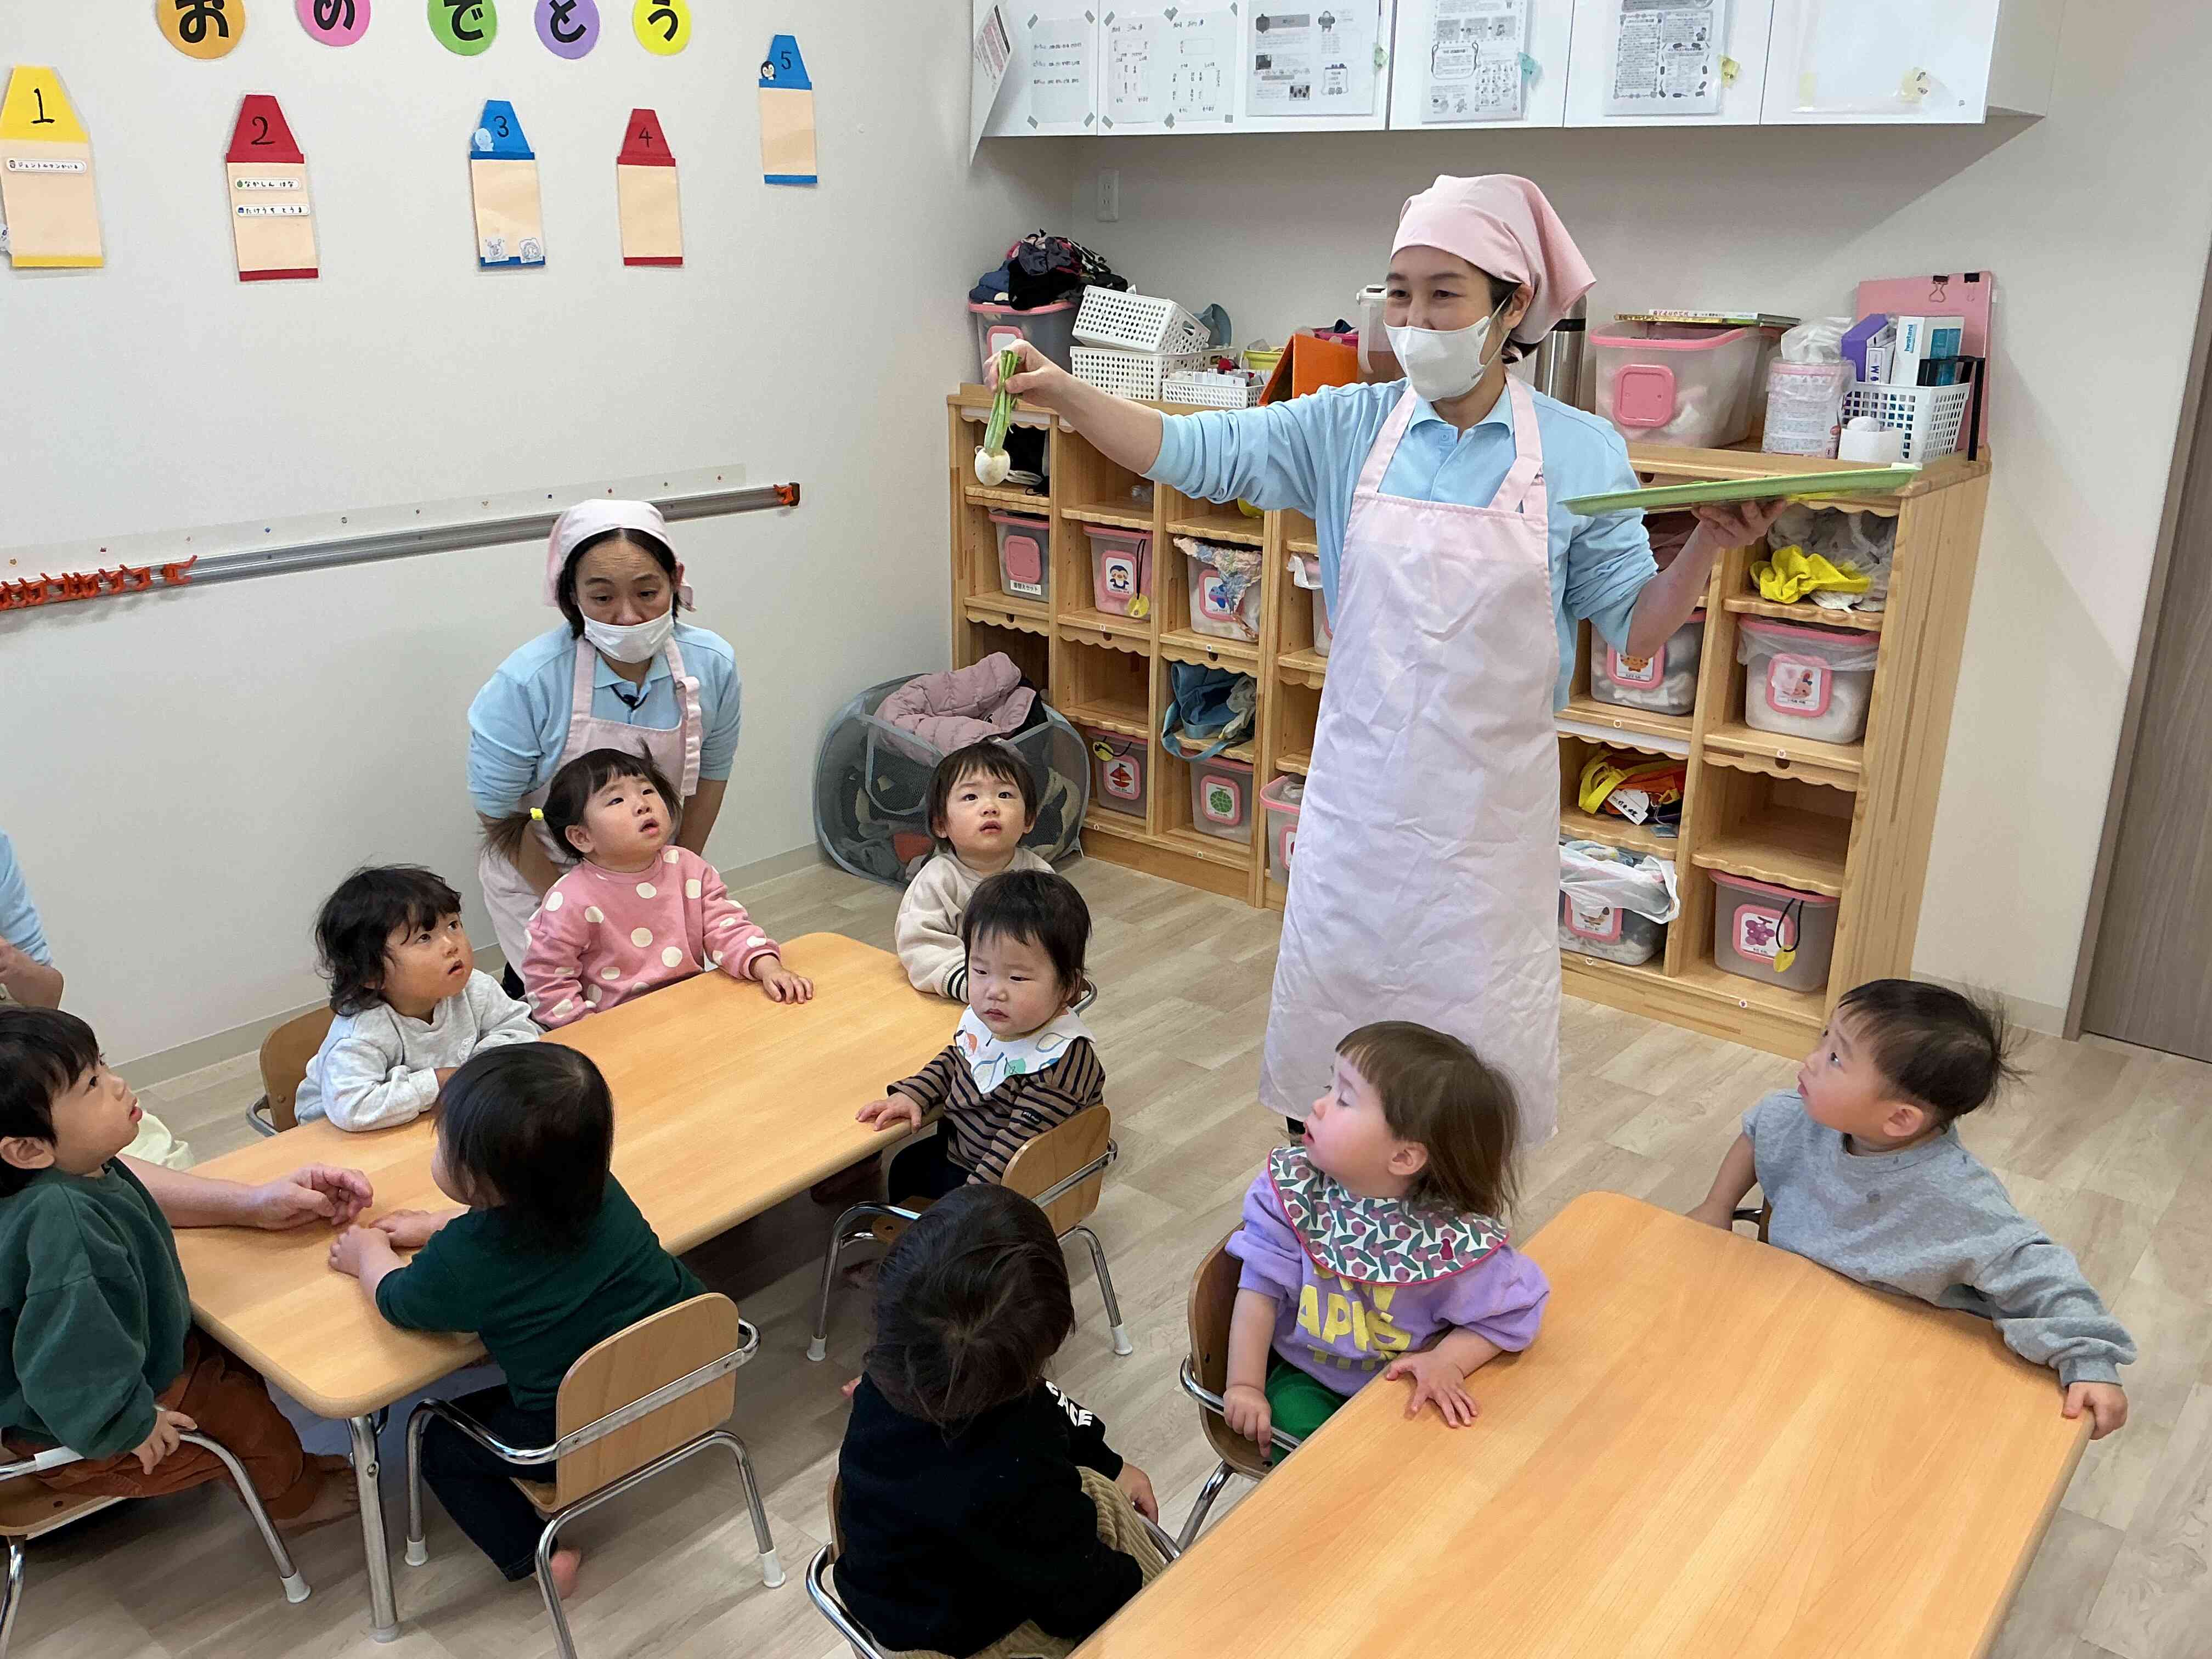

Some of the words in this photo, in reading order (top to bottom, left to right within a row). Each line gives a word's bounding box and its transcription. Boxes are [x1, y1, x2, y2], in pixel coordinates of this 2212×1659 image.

[781, 50, 792, 70] 5
[31, 88, 55, 124] 1
[250, 116, 276, 146] 2
[494, 115, 510, 138] 3
[638, 127, 654, 148] 4
